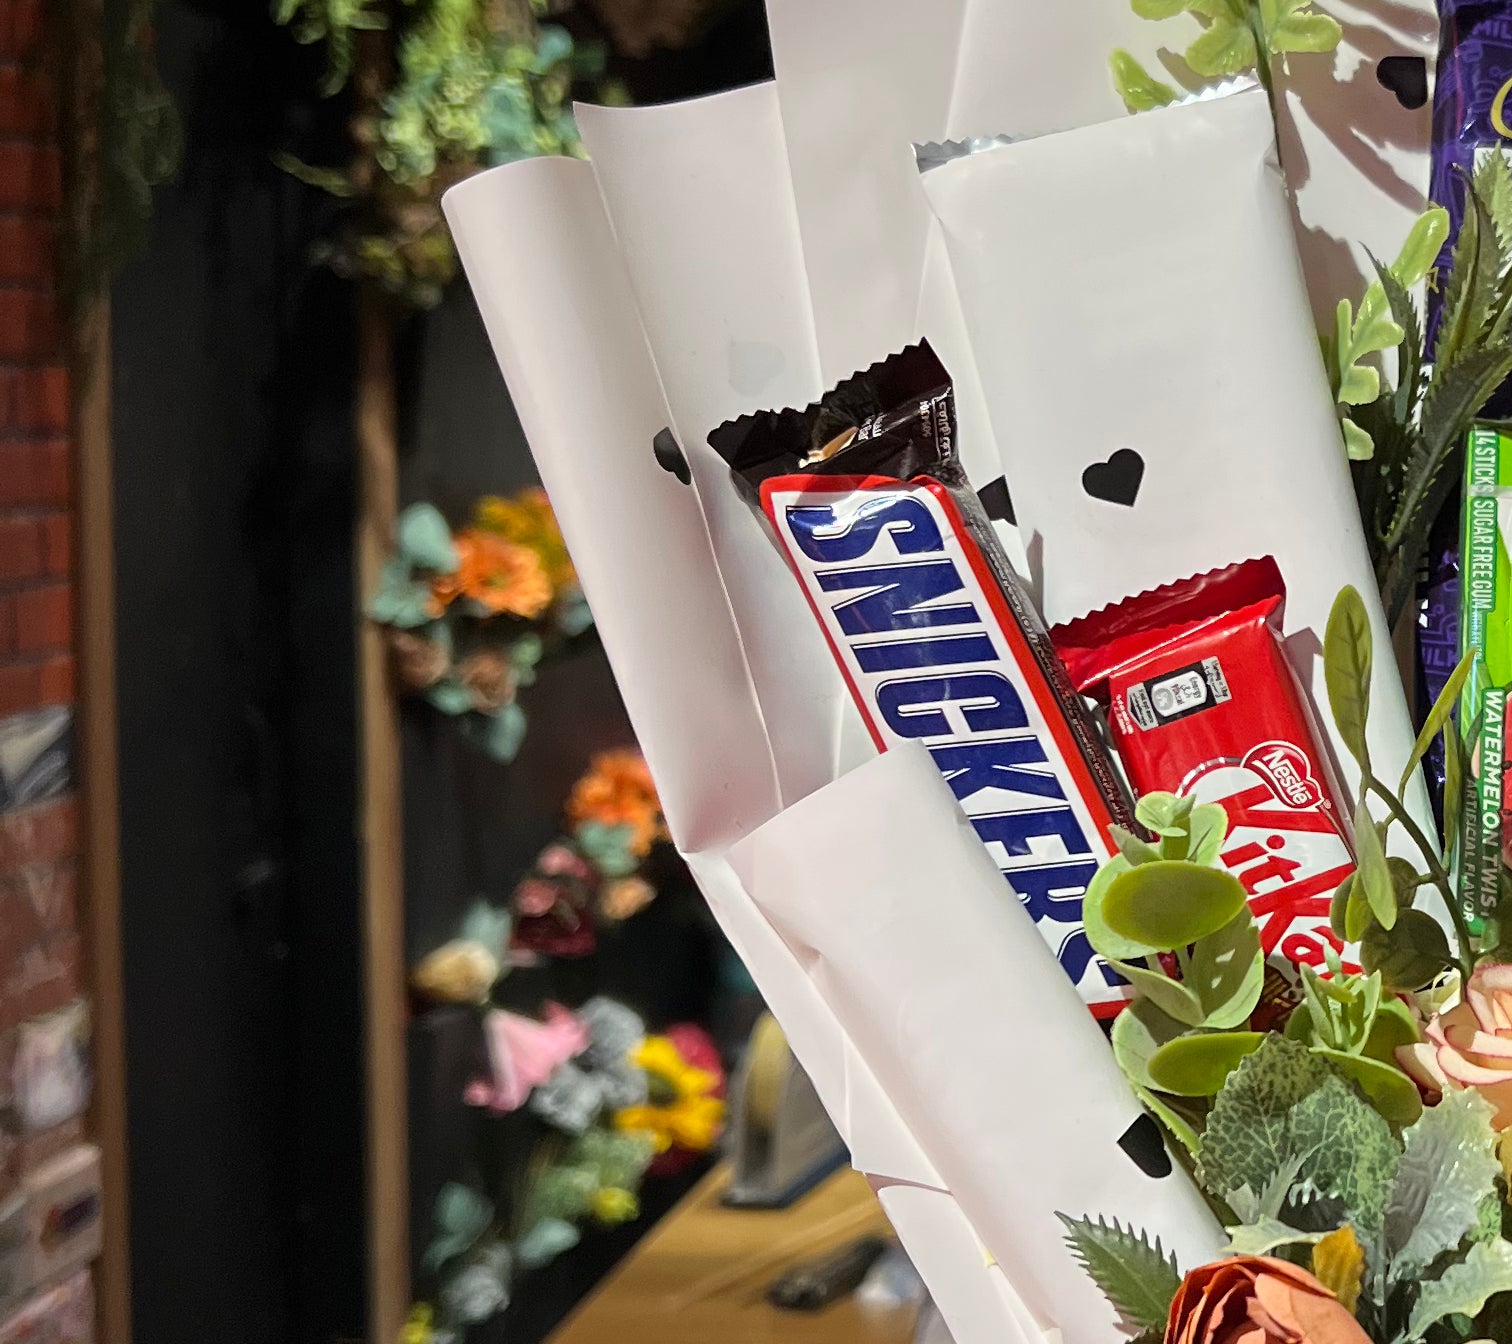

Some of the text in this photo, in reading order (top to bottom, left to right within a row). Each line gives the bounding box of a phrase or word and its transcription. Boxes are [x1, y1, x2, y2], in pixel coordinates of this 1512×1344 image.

[1472, 500, 1495, 548] SUGAR
[1471, 548, 1494, 583] FREE
[1470, 583, 1493, 610] GUM
[1481, 690, 1505, 848] WATERMELON
[1462, 862, 1476, 923] FLAVOR
